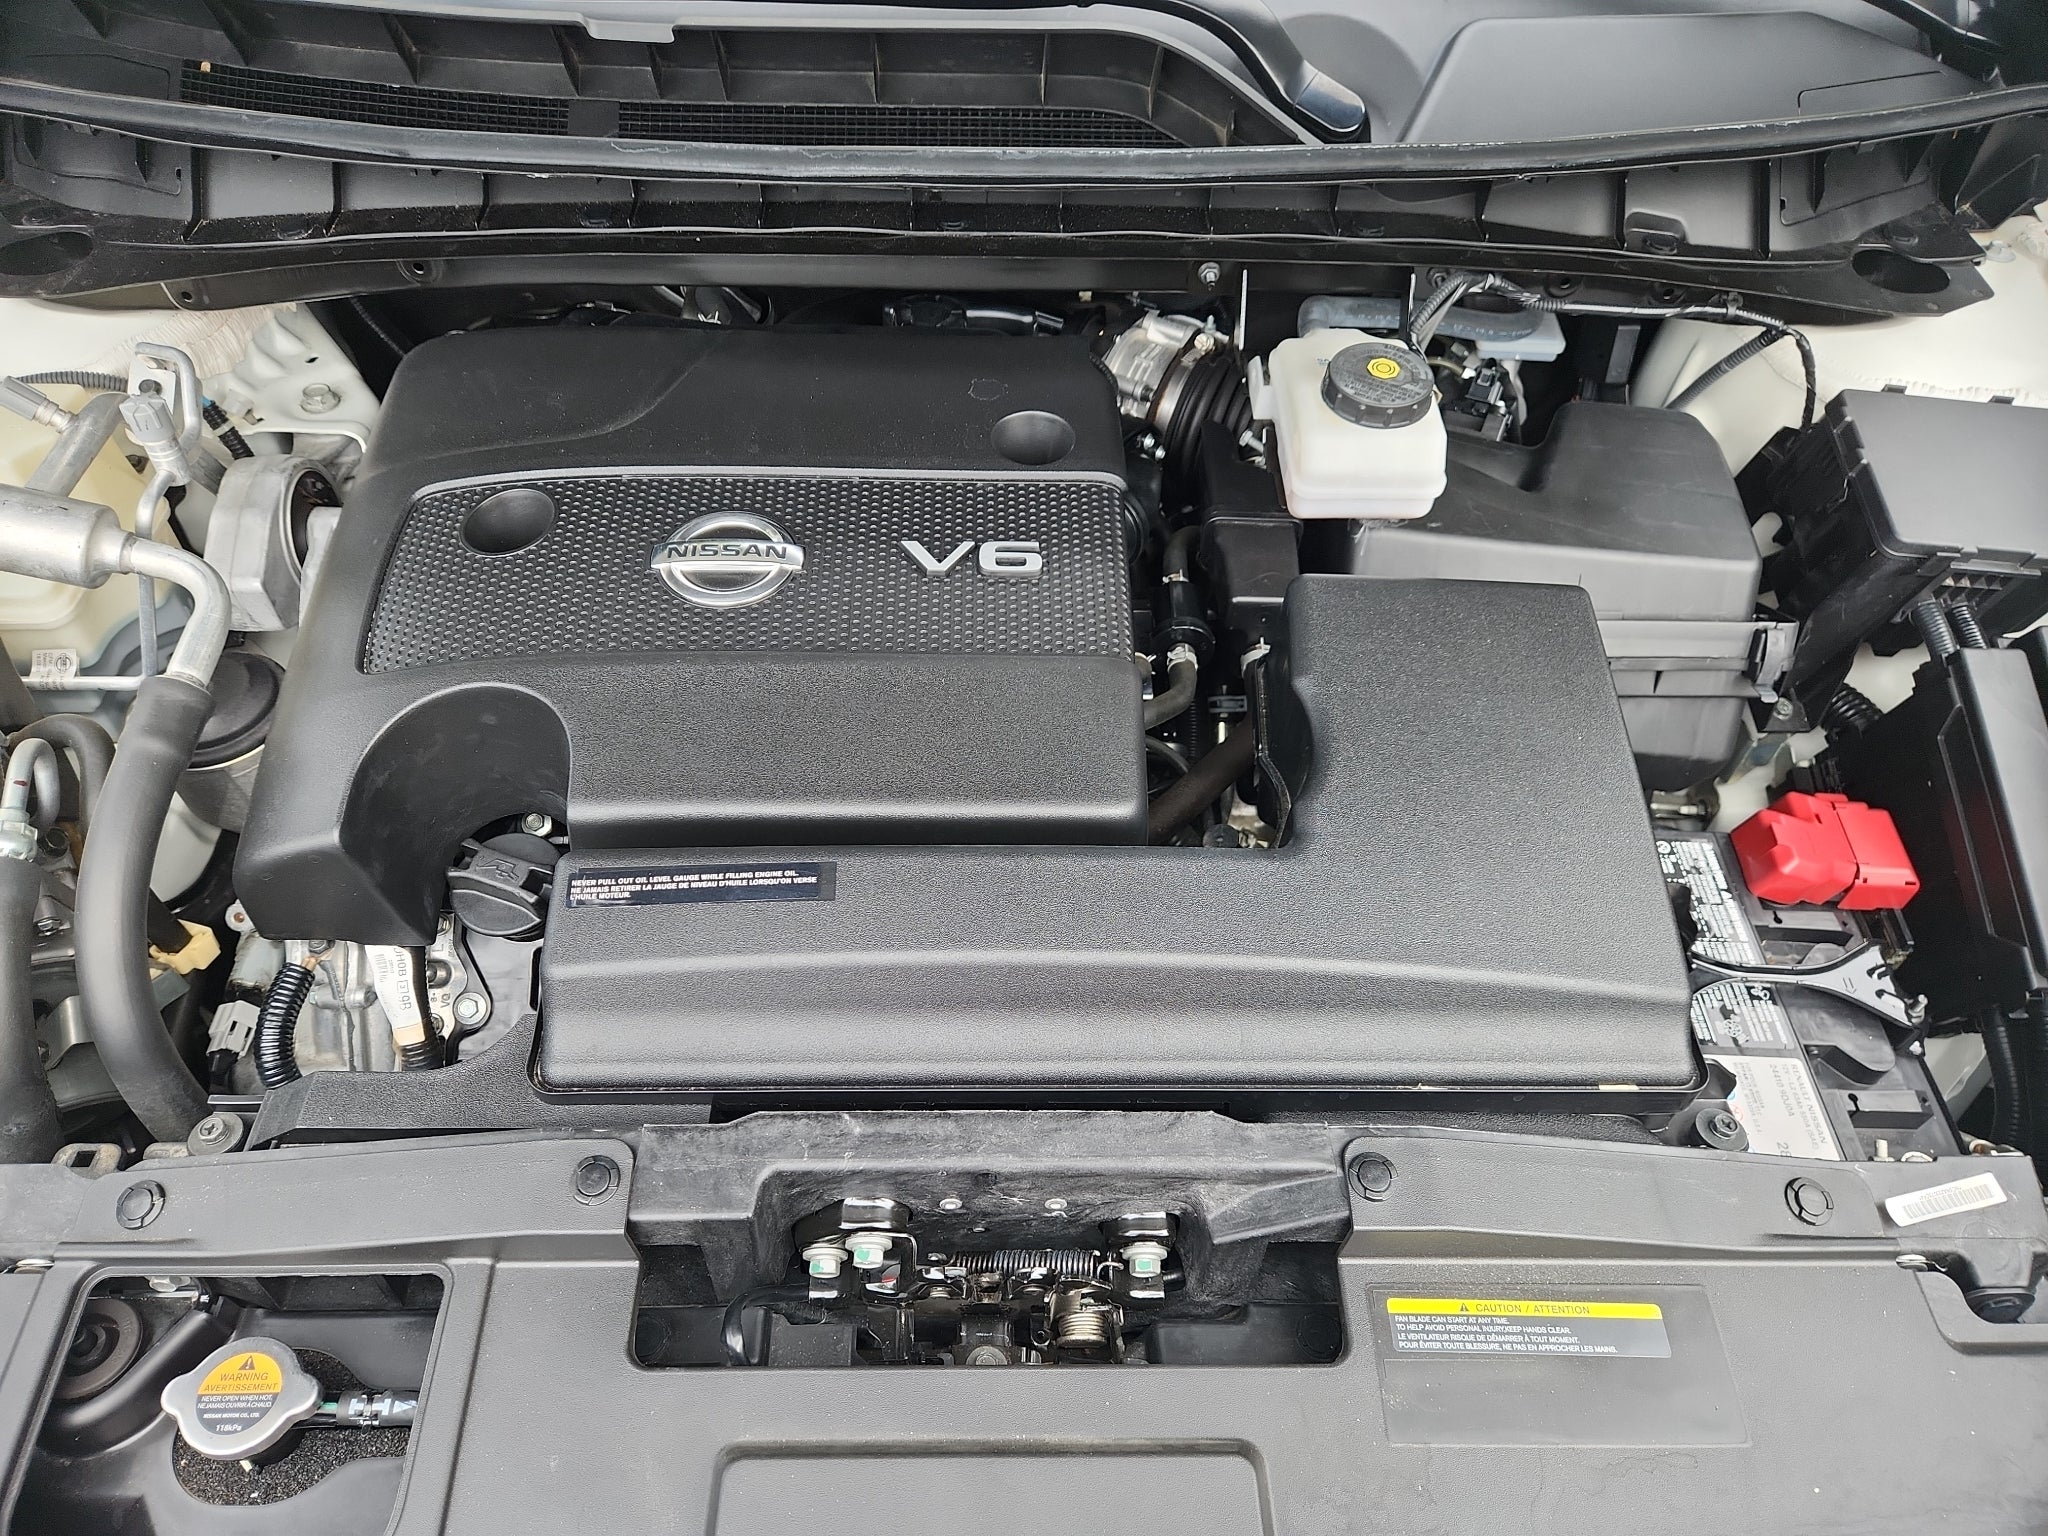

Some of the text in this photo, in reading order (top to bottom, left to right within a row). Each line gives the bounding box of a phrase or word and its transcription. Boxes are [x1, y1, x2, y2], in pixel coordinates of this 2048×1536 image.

[667, 542, 787, 560] NISSAN
[901, 541, 1043, 578] V6
[673, 874, 699, 882] GAUGE
[653, 882, 677, 890] JAUGE
[678, 881, 689, 889] DE
[719, 879, 748, 887] D'HUILE
[749, 878, 791, 886] LORSQU'ON
[1791, 1064, 1828, 1144] RENAULT NISSAN
[1475, 1303, 1521, 1313] CAUTION
[1533, 1304, 1590, 1314] ATTENTION
[1395, 1315, 1408, 1323] FAN
[1548, 1326, 1572, 1334] CLEAR.
[1407, 1333, 1450, 1341] VENTILATEUR
[1466, 1342, 1502, 1350] BLESSURE,
[1539, 1344, 1580, 1352] APPROCHER
[220, 1372, 269, 1381] WARNING
[204, 1383, 278, 1391] AVERTISSEMENT
[216, 1424, 242, 1432] 118kPa
